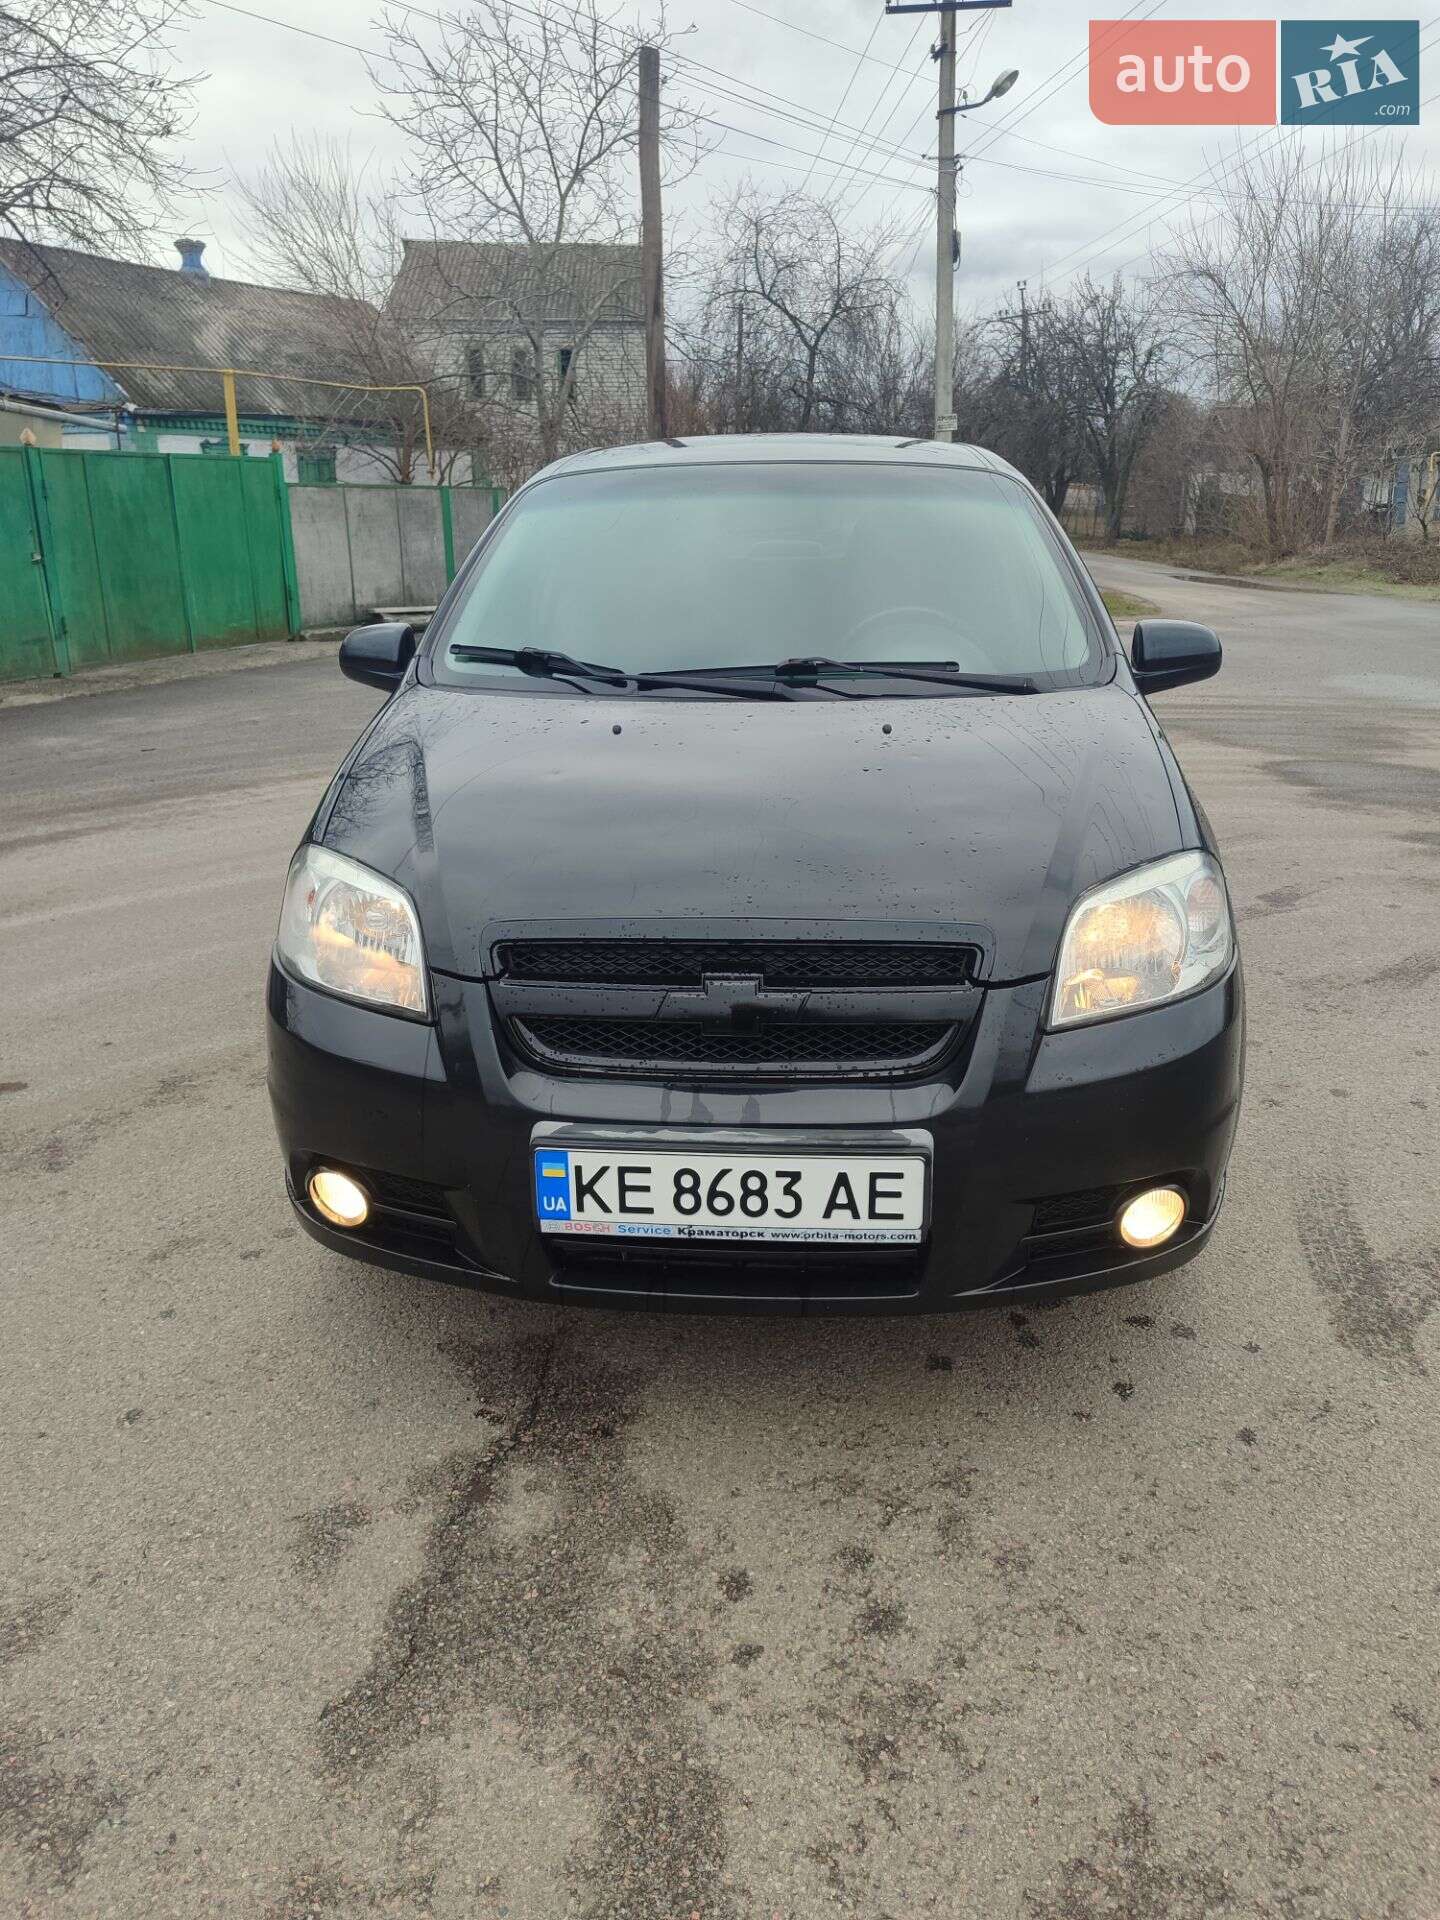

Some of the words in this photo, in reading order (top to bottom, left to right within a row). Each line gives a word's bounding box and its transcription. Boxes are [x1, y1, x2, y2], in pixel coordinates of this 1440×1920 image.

[574, 1165, 654, 1214] KE
[672, 1167, 803, 1218] 8683
[822, 1171, 905, 1220] AE
[543, 1196, 567, 1212] UA
[564, 1222, 611, 1233] BOSCH
[617, 1224, 673, 1236] Service
[677, 1226, 766, 1239] Краматорск
